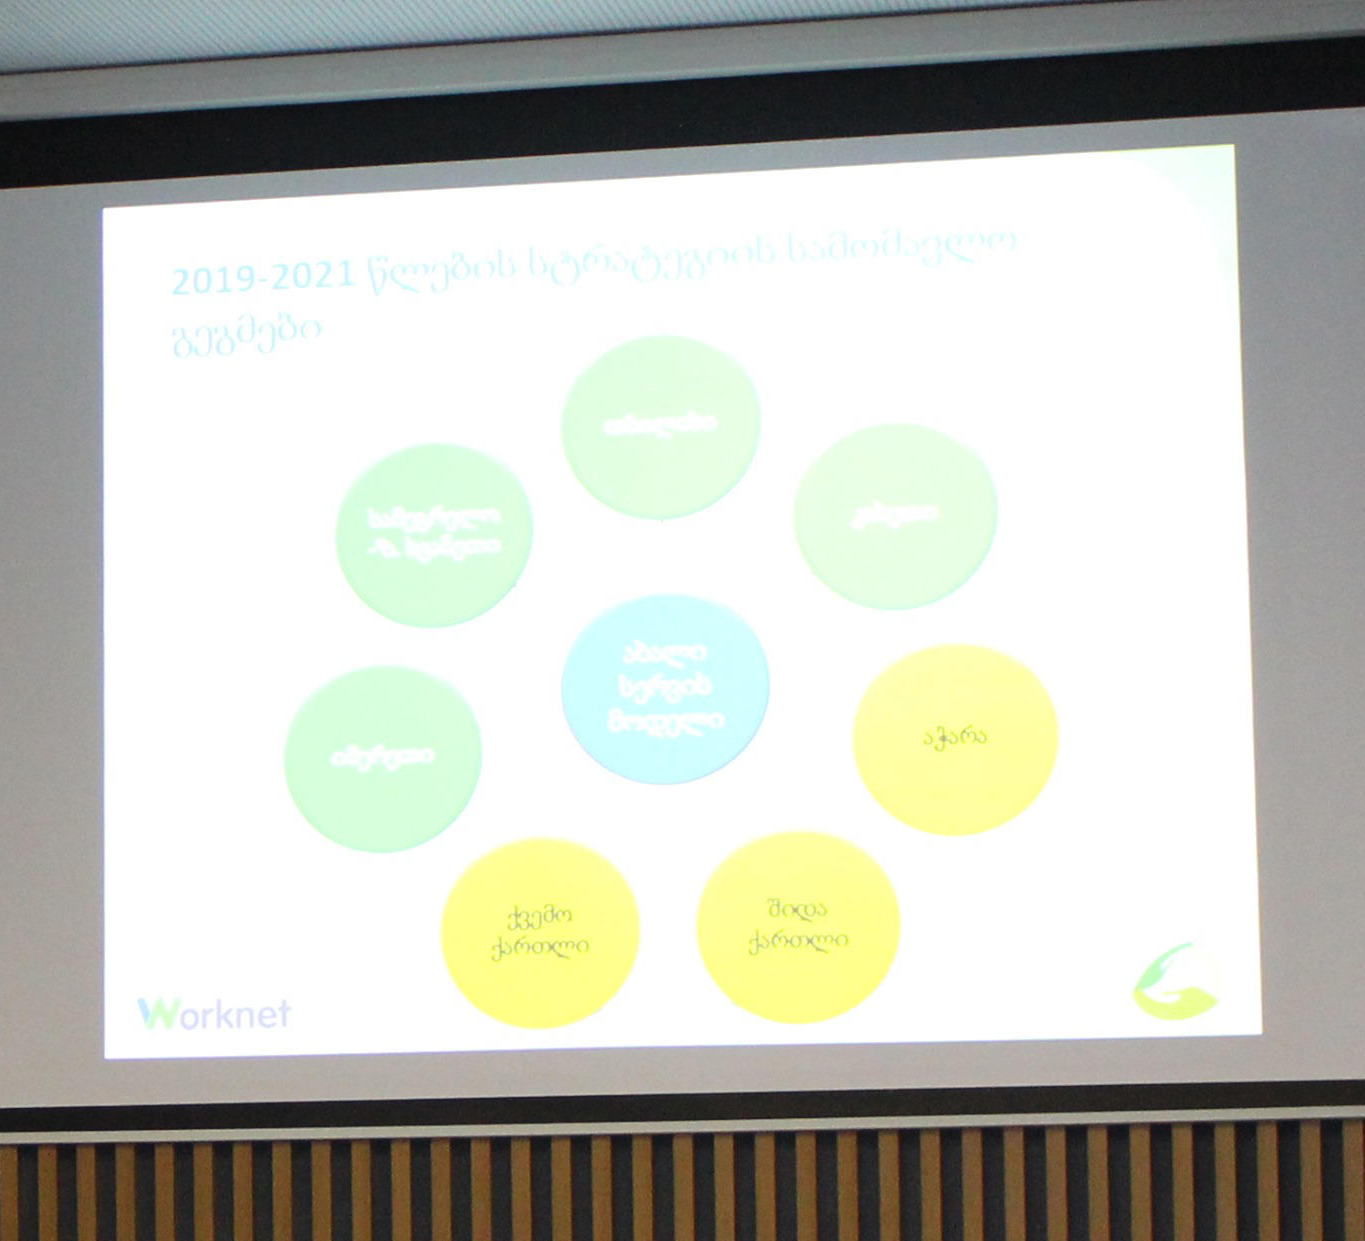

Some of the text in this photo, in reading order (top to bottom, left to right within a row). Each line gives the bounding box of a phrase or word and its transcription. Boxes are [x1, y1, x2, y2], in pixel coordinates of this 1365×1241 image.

[172, 227, 1018, 297] 2019-2021 წლების სტრატეგიის სამომავლო
[171, 311, 323, 359] გეგმები
[922, 723, 990, 753] აჭარა
[506, 903, 574, 932] ქვემო
[766, 896, 830, 925] შიდა
[490, 933, 591, 963] ქართლი
[747, 927, 851, 958] ქართლი
[137, 996, 293, 1031] Worknet
